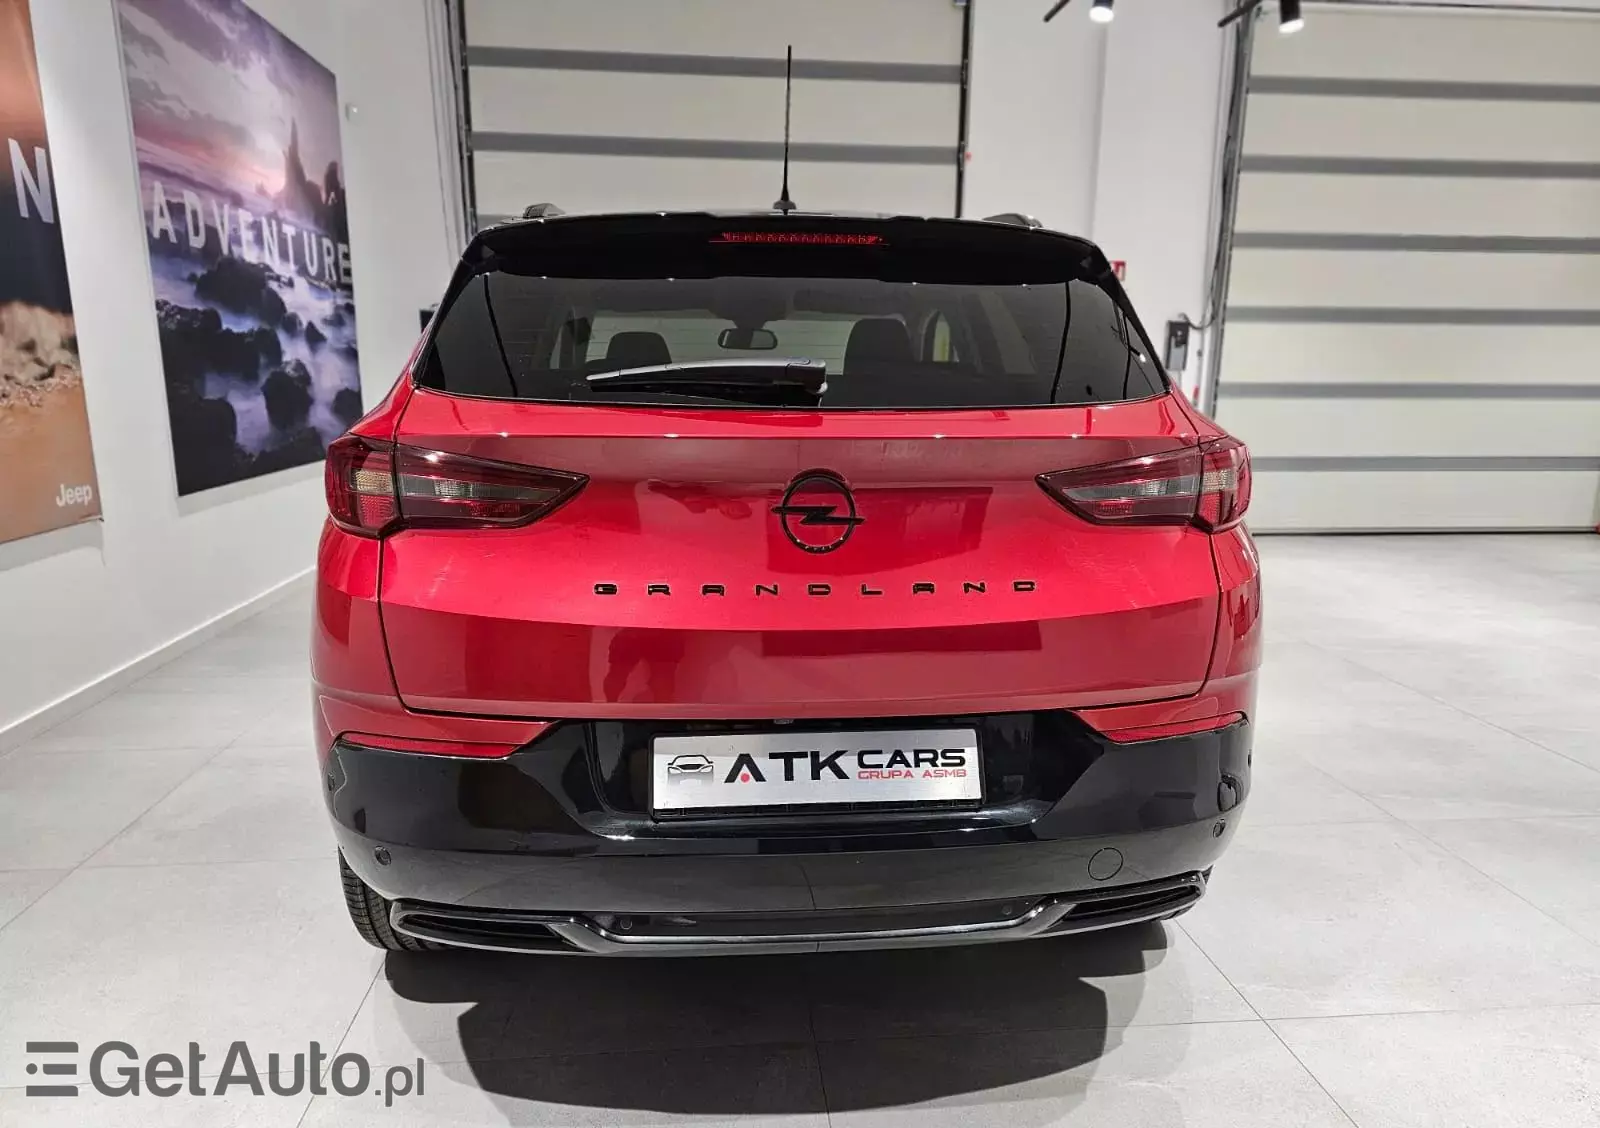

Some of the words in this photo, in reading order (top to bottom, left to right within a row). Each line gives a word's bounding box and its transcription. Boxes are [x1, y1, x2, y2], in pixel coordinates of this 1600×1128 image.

[151, 180, 353, 285] ADVENTURE
[56, 483, 92, 507] Jeep
[593, 580, 1036, 597] GRANDLAND
[724, 750, 850, 784] ATK
[857, 748, 966, 769] CARS
[857, 769, 914, 780] GRUPA
[922, 768, 967, 779] ASMB
